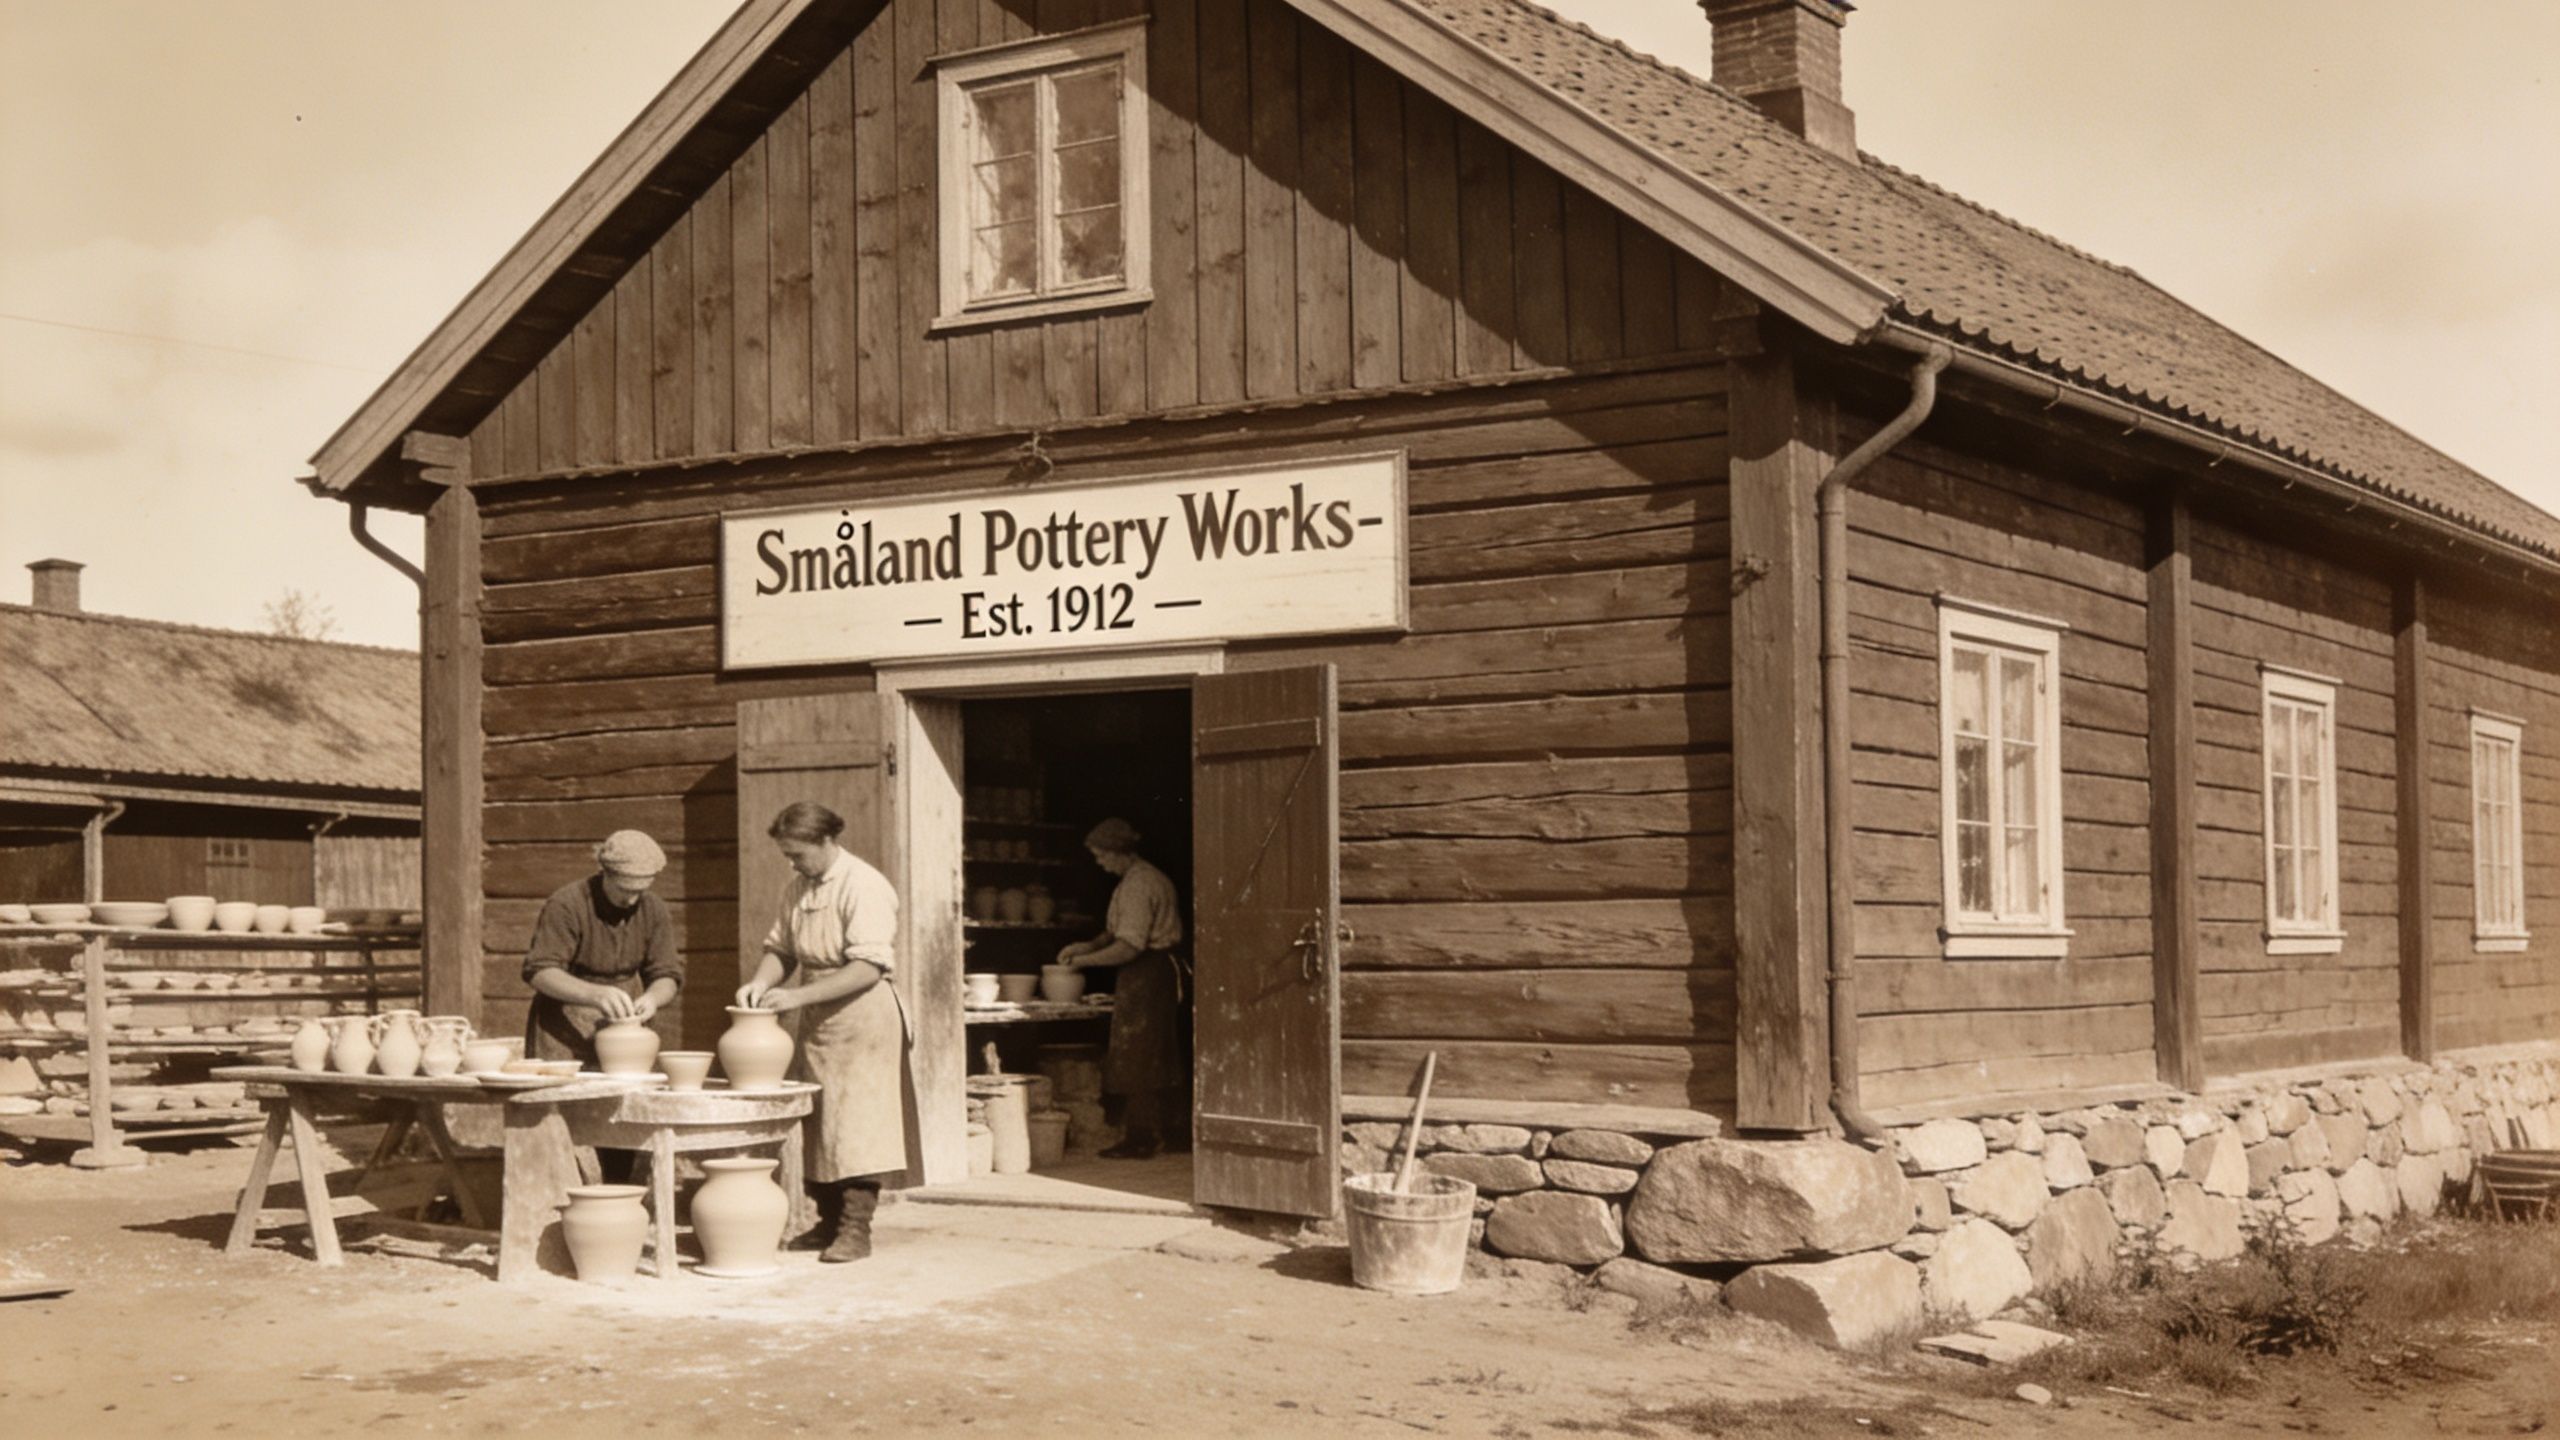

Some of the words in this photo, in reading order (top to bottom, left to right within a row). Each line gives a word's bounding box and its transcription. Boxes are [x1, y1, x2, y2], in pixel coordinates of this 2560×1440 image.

[755, 509, 963, 597] Småland
[981, 508, 1170, 580] Pottery
[960, 591, 1034, 640] Est.
[1046, 582, 1136, 634] 1912
